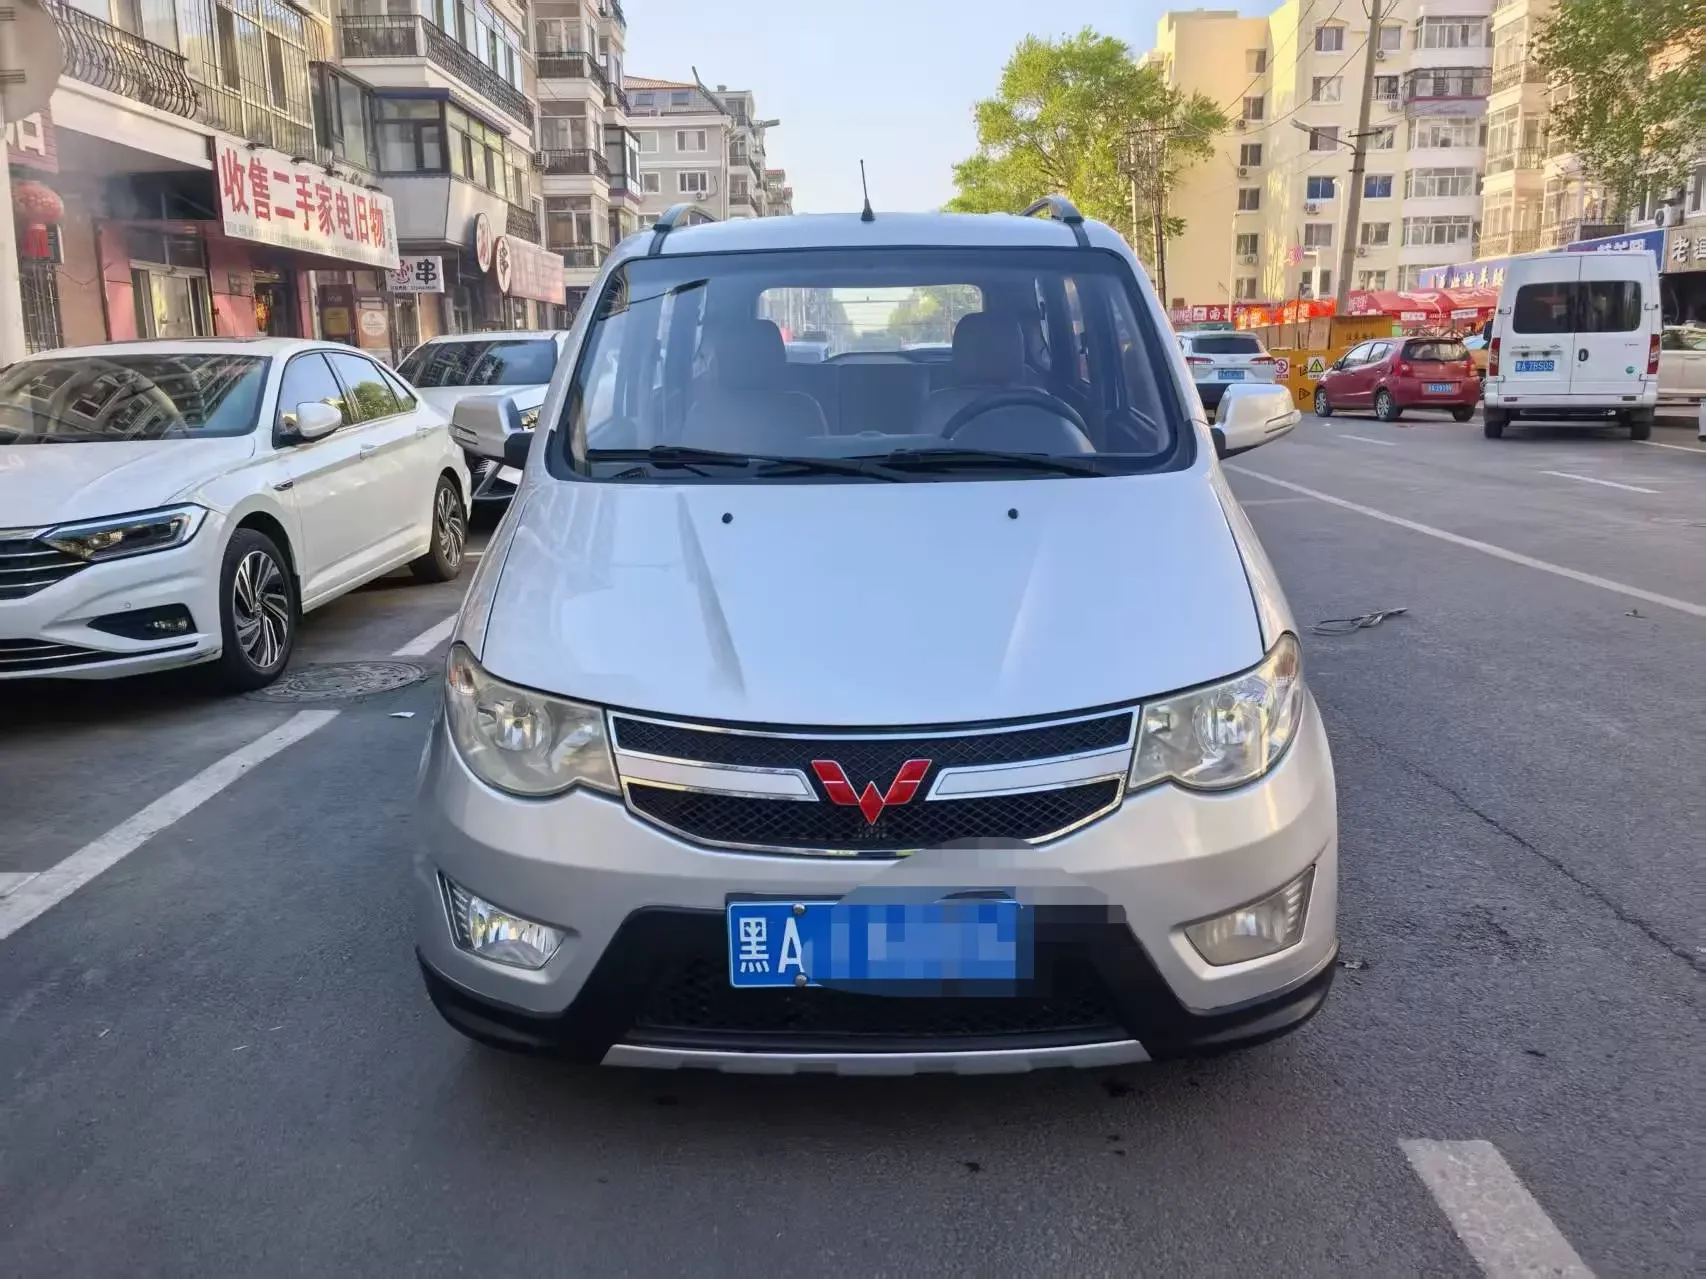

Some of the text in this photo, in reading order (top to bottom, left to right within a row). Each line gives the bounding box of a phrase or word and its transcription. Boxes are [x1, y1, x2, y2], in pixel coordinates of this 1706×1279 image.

[221, 147, 386, 248] 收售二手家电旧物
